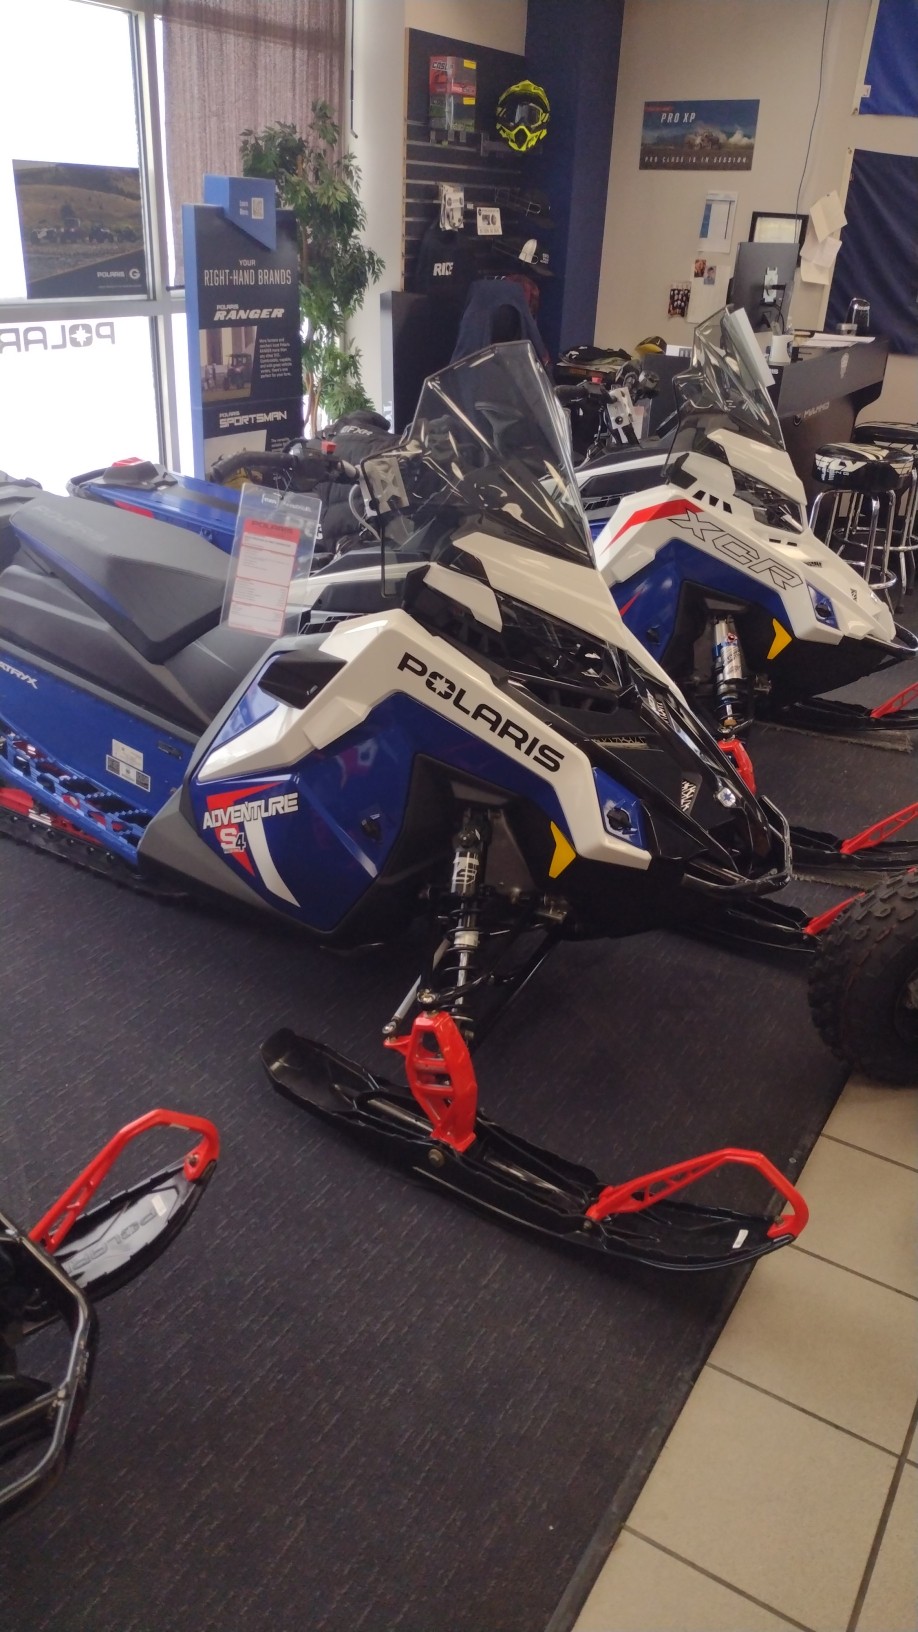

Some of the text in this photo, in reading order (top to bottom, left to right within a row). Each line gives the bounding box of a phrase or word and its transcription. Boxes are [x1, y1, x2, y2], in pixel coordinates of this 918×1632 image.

[660, 112, 696, 123] PRO XP
[238, 259, 256, 267] YOUR
[204, 269, 292, 287] RIGHT-HAND BRANDS
[213, 308, 285, 321] RANGER
[219, 410, 288, 429] SPORTSMAN
[667, 508, 803, 591] XCR
[397, 651, 565, 773] POLARIS
[202, 792, 299, 830] ADVENTURE
